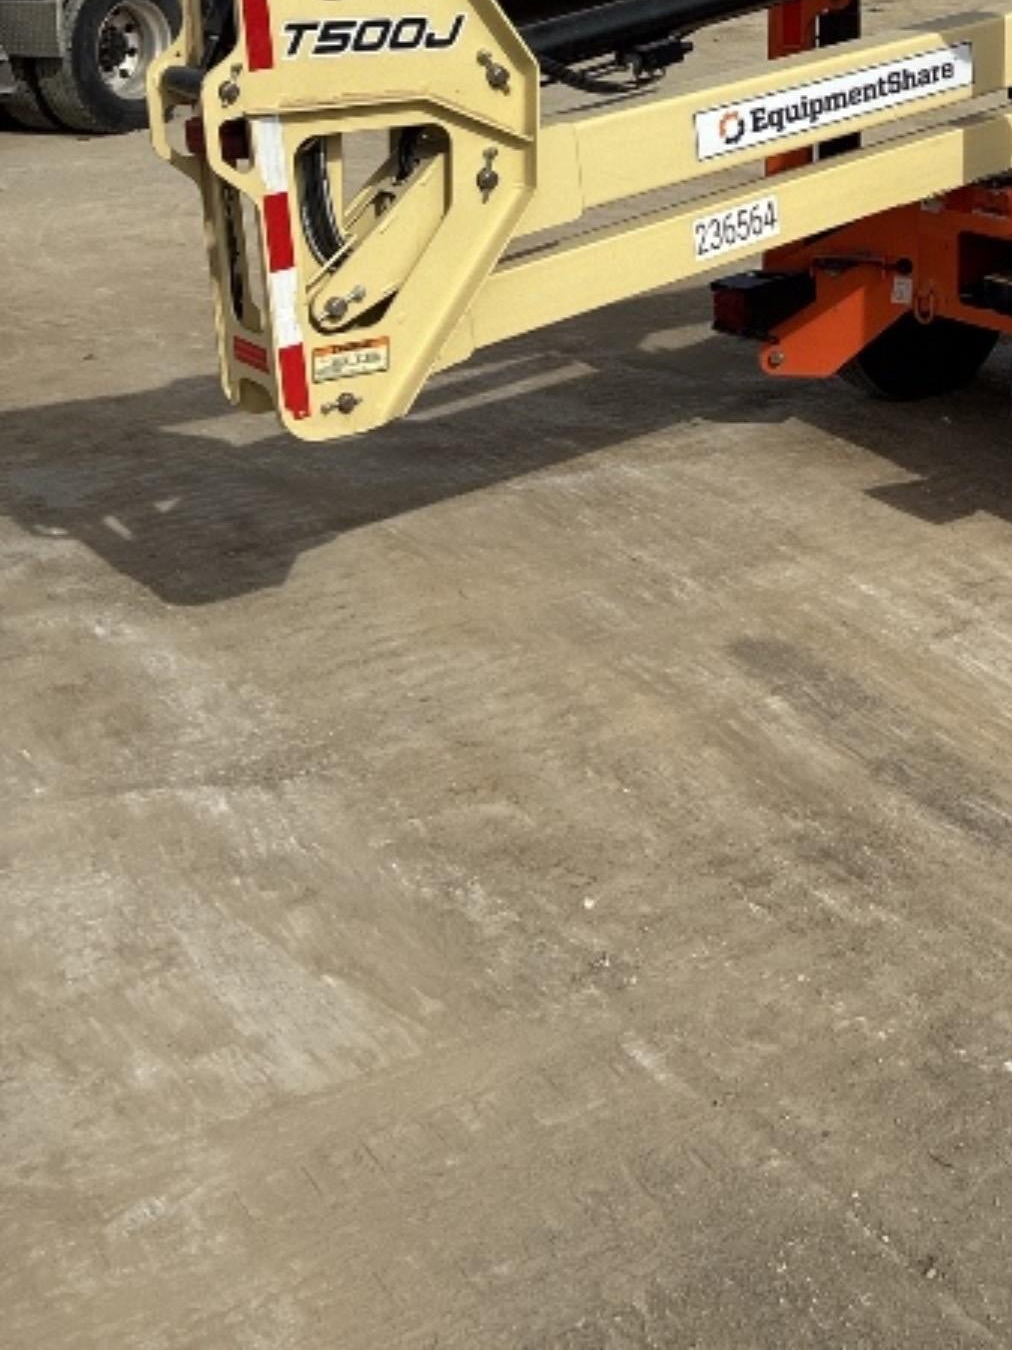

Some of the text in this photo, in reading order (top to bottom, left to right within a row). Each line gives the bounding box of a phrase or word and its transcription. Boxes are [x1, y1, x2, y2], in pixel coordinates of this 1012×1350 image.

[283, 14, 466, 57] T500J
[750, 61, 955, 134] EquipmentShare
[694, 200, 777, 256] 236564
